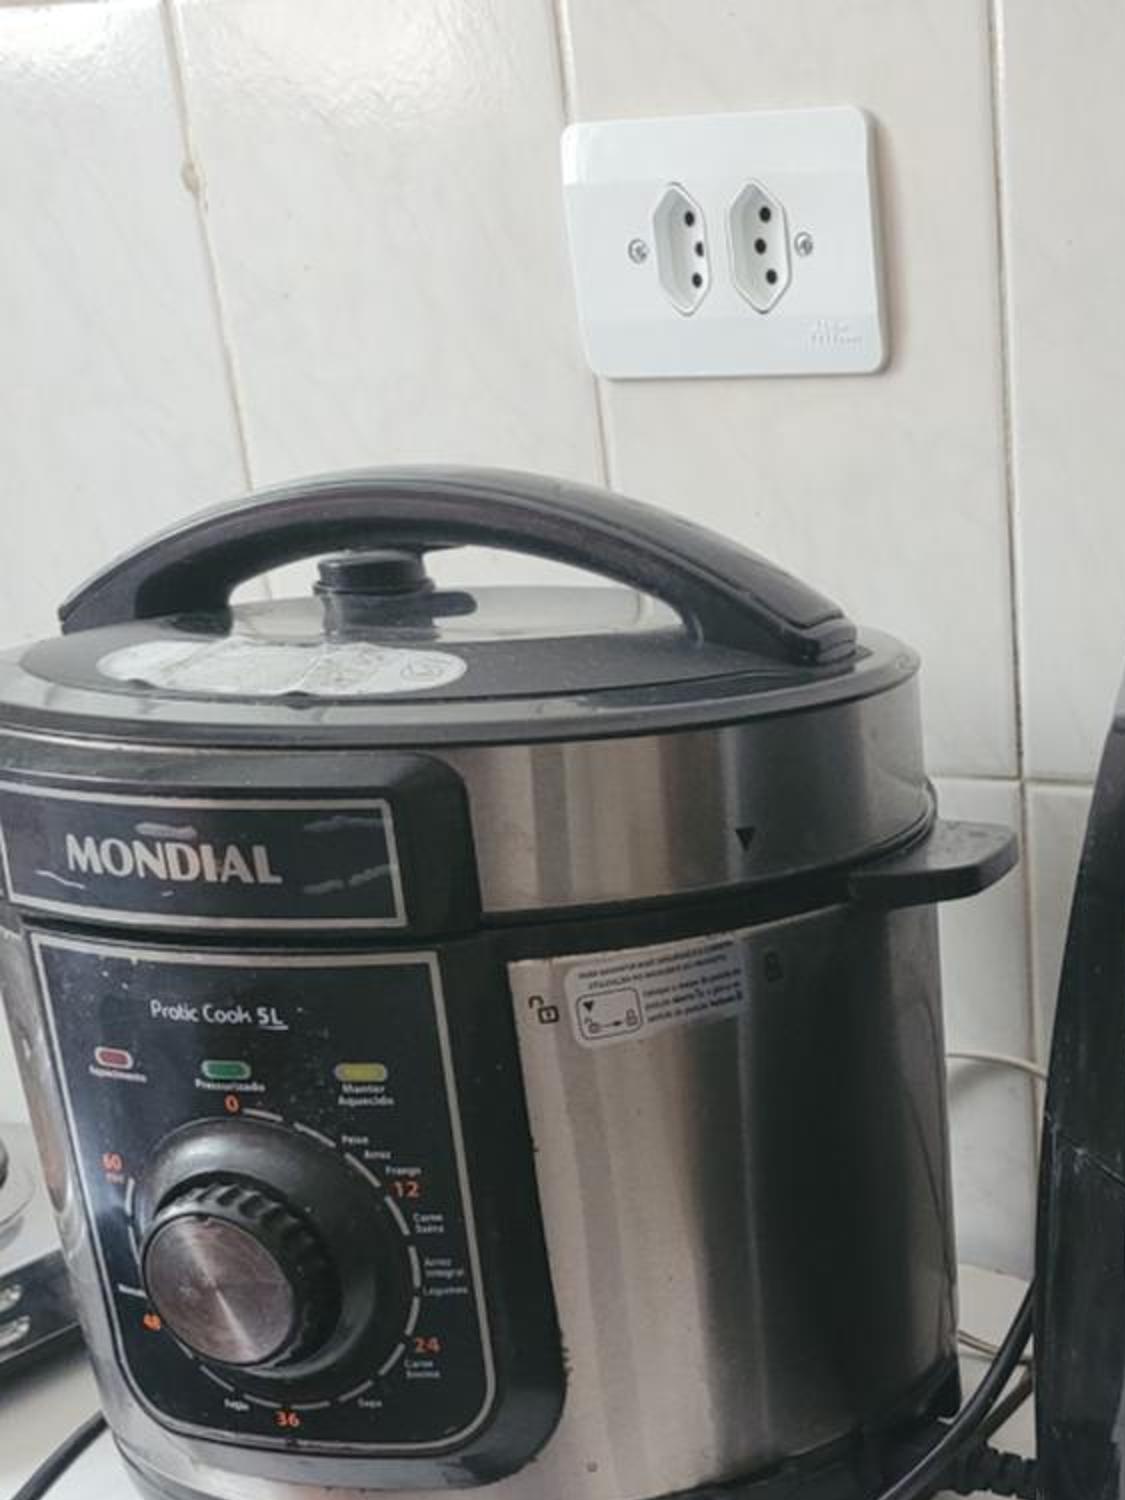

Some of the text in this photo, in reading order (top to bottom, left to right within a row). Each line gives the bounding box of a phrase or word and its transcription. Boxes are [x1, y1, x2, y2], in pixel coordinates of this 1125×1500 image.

[65, 832, 284, 885] MONDIAL
[202, 1002, 253, 1023] Cook
[256, 1005, 285, 1026] 5L
[225, 1094, 240, 1113] 0
[392, 1181, 420, 1198] 12
[273, 1409, 301, 1428] 36
